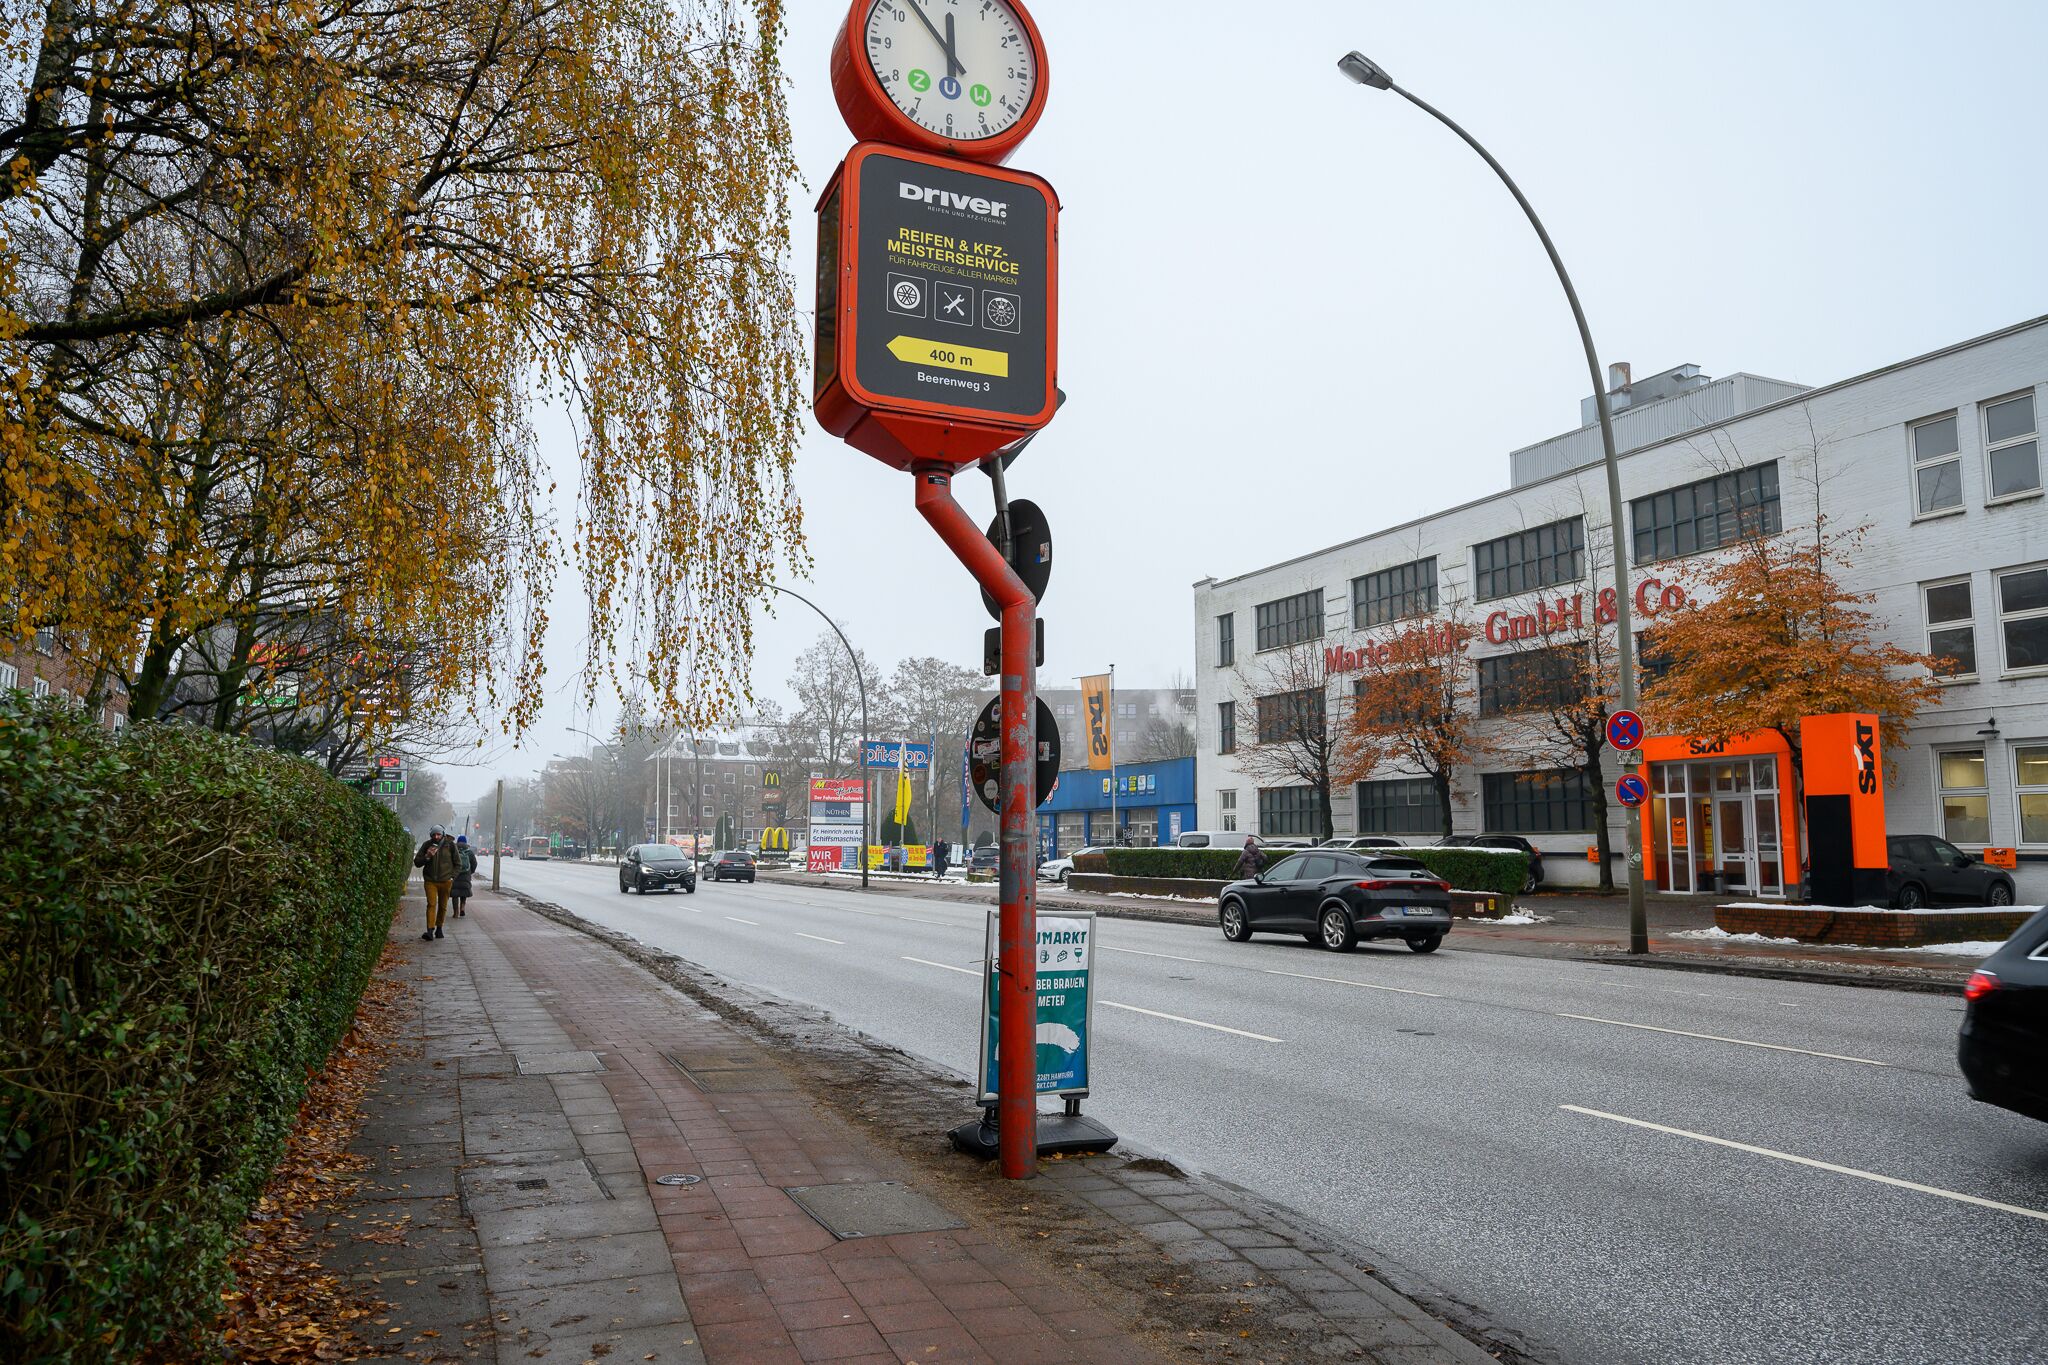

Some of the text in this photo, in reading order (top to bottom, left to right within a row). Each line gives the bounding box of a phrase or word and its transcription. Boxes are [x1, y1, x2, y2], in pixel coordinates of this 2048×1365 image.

[891, 9, 905, 22] 10
[979, 10, 985, 21] 1
[884, 37, 892, 49] 9
[1000, 36, 1008, 48] 2
[892, 69, 899, 81] 8
[1007, 67, 1015, 79] 3
[913, 72, 988, 103] Z U W
[914, 97, 922, 109] 7
[999, 95, 1006, 107] 4
[946, 114, 953, 126] 6
[978, 112, 985, 124] 5
[927, 205, 1007, 226] REIFEN UND KFZ-TECHNIK
[899, 227, 1009, 258] REIFEN & KFZ-
[887, 239, 1019, 275] MEISTERSERVICE
[889, 254, 1018, 285] FÜR FAHRZEUGE ALLER MARKEN
[929, 349, 973, 366] 400 m
[917, 370, 990, 392] Beerenweg 3
[1485, 593, 1583, 644] GmbH
[1596, 587, 1618, 624] &
[1325, 621, 1471, 675] Marielde
[812, 835, 863, 843] Schiffsmaschine
[810, 850, 832, 860] WIR
[1053, 976, 1085, 990] BRAUEN
[1037, 995, 1066, 1007] METER
[1050, 1070, 1074, 1080] HAMBURG
